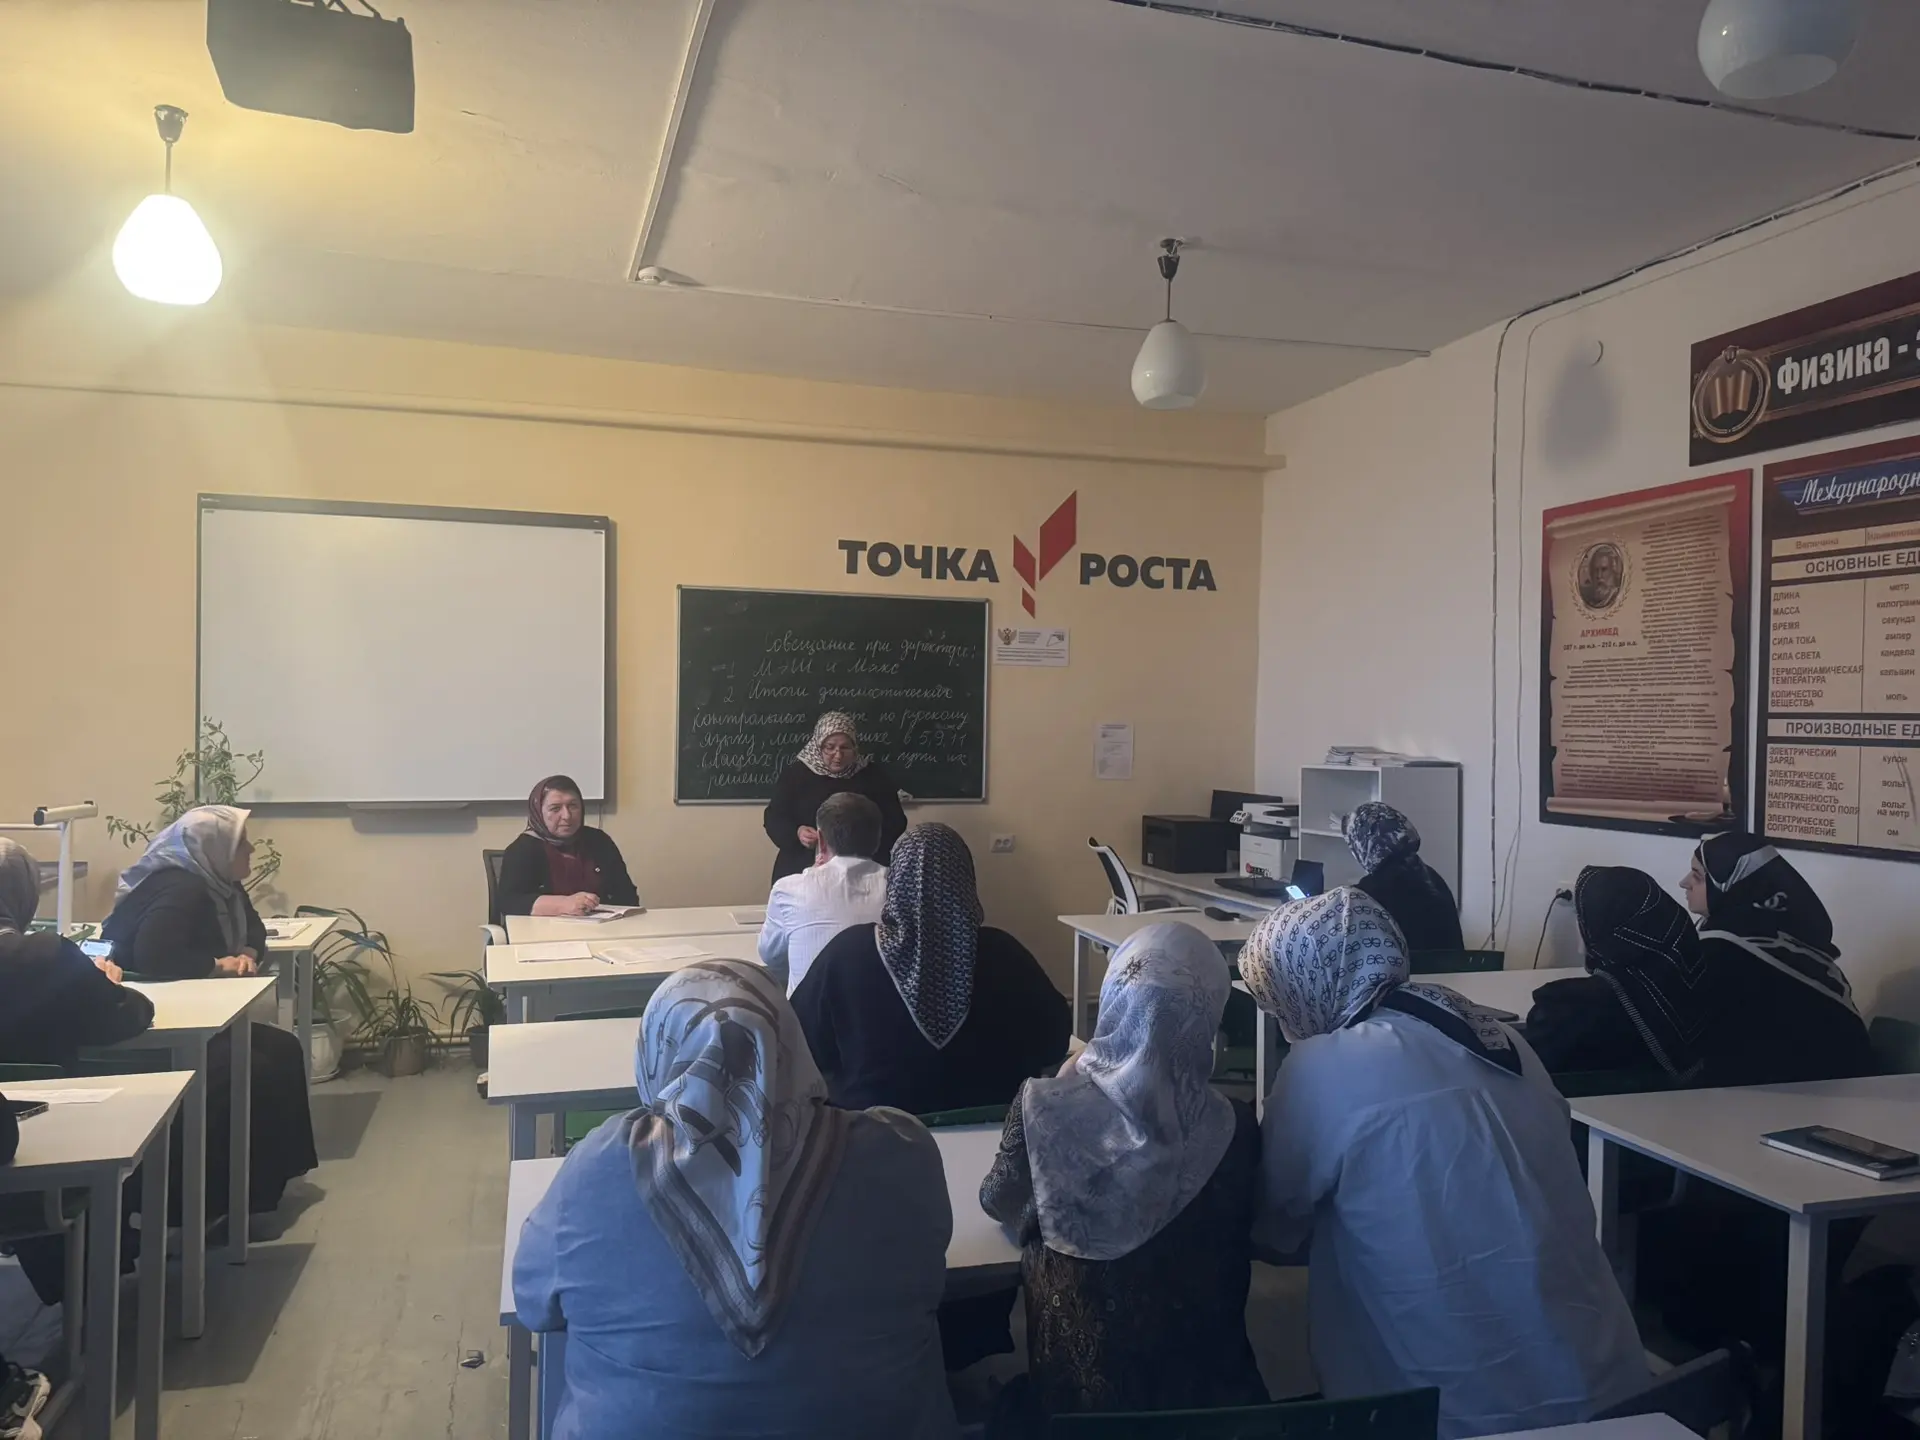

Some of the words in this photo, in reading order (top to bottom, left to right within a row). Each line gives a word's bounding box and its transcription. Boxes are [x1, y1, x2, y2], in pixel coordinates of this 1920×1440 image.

[838, 539, 1000, 583] ТОЧКА
[1079, 552, 1218, 592] РОСТА
[1805, 554, 1891, 574] ОСНОВНЫЕ
[1889, 583, 1910, 593] метр
[1772, 592, 1801, 602] ДЛИНА
[1772, 606, 1801, 616] МАССА
[1881, 615, 1916, 626] секунда
[1772, 621, 1800, 631] ВРЕМЯ
[1580, 627, 1619, 638] АРХИМЕД
[1885, 632, 1912, 642] ампер
[1772, 636, 1794, 646] СИЛА
[1796, 635, 1817, 645] ТОКА
[1771, 651, 1794, 661] СИЛА
[1795, 650, 1822, 660] СВЕТА
[1880, 648, 1915, 658] кандела
[1771, 665, 1864, 676] ТЕРМОДИНАМИЧЕСКАЯ
[1879, 667, 1916, 677] кельвин
[1771, 675, 1827, 685] ТЕМПЕРАТУРА
[1771, 690, 1824, 699] КОЛИЧЕСТВО
[1885, 692, 1909, 701] моль
[1770, 699, 1815, 708] ВЕЩЕСТВА
[1785, 722, 1897, 737] ПРОИЗВОДНЫЕ
[1769, 746, 1837, 757] ЭЛЕКТРИЧЕСКИЙ
[1768, 755, 1796, 766] ЗАРЯД
[1882, 755, 1908, 765] кулон
[1768, 769, 1837, 781] ЭЛЕКТРИЧЕСКОЕ
[1826, 781, 1845, 791] ЭДС
[1881, 780, 1907, 788] вольт
[1767, 791, 1840, 805] НАПРЯЖЕННОСТЬ
[1767, 800, 1837, 814] ЭЛЕКТРИЧЕСКОГО
[1881, 800, 1907, 809] вольт
[1876, 808, 1888, 816] на
[1889, 809, 1911, 819] метр
[1767, 814, 1836, 828] ЭЛЕКТРИЧЕСКОЕ
[1766, 822, 1837, 837] СОПРОТИВЛЕНИЕ
[1886, 828, 1900, 836] ом
